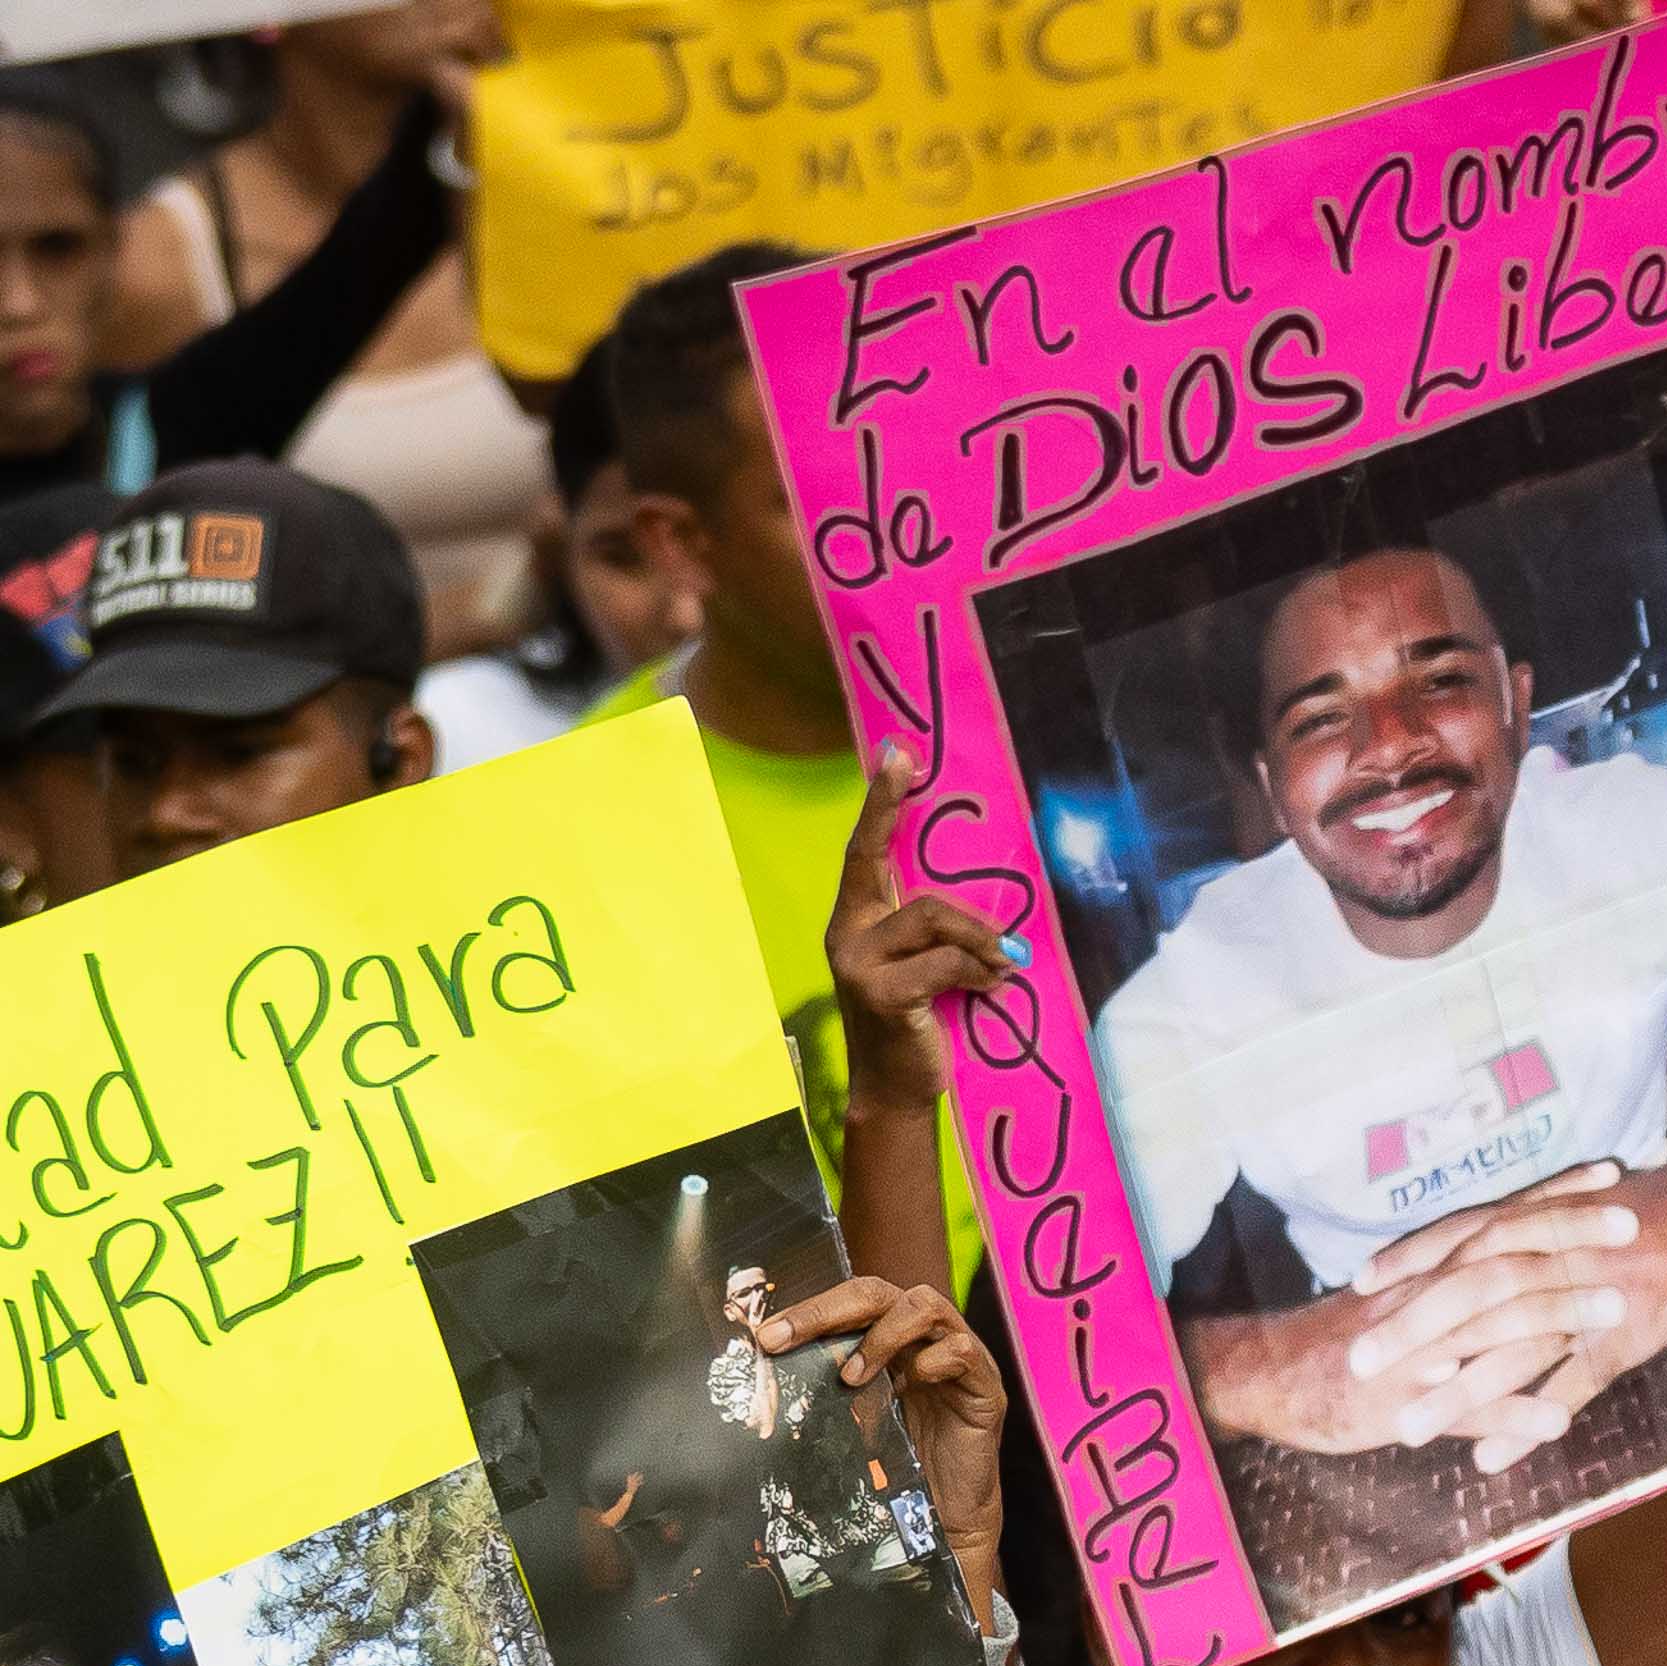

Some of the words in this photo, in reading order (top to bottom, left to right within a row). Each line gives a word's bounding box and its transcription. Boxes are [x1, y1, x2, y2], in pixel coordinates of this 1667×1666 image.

[832, 225, 1075, 428] En
[1119, 155, 1253, 323] el
[814, 428, 953, 591] de
[226, 895, 577, 1131] Para
